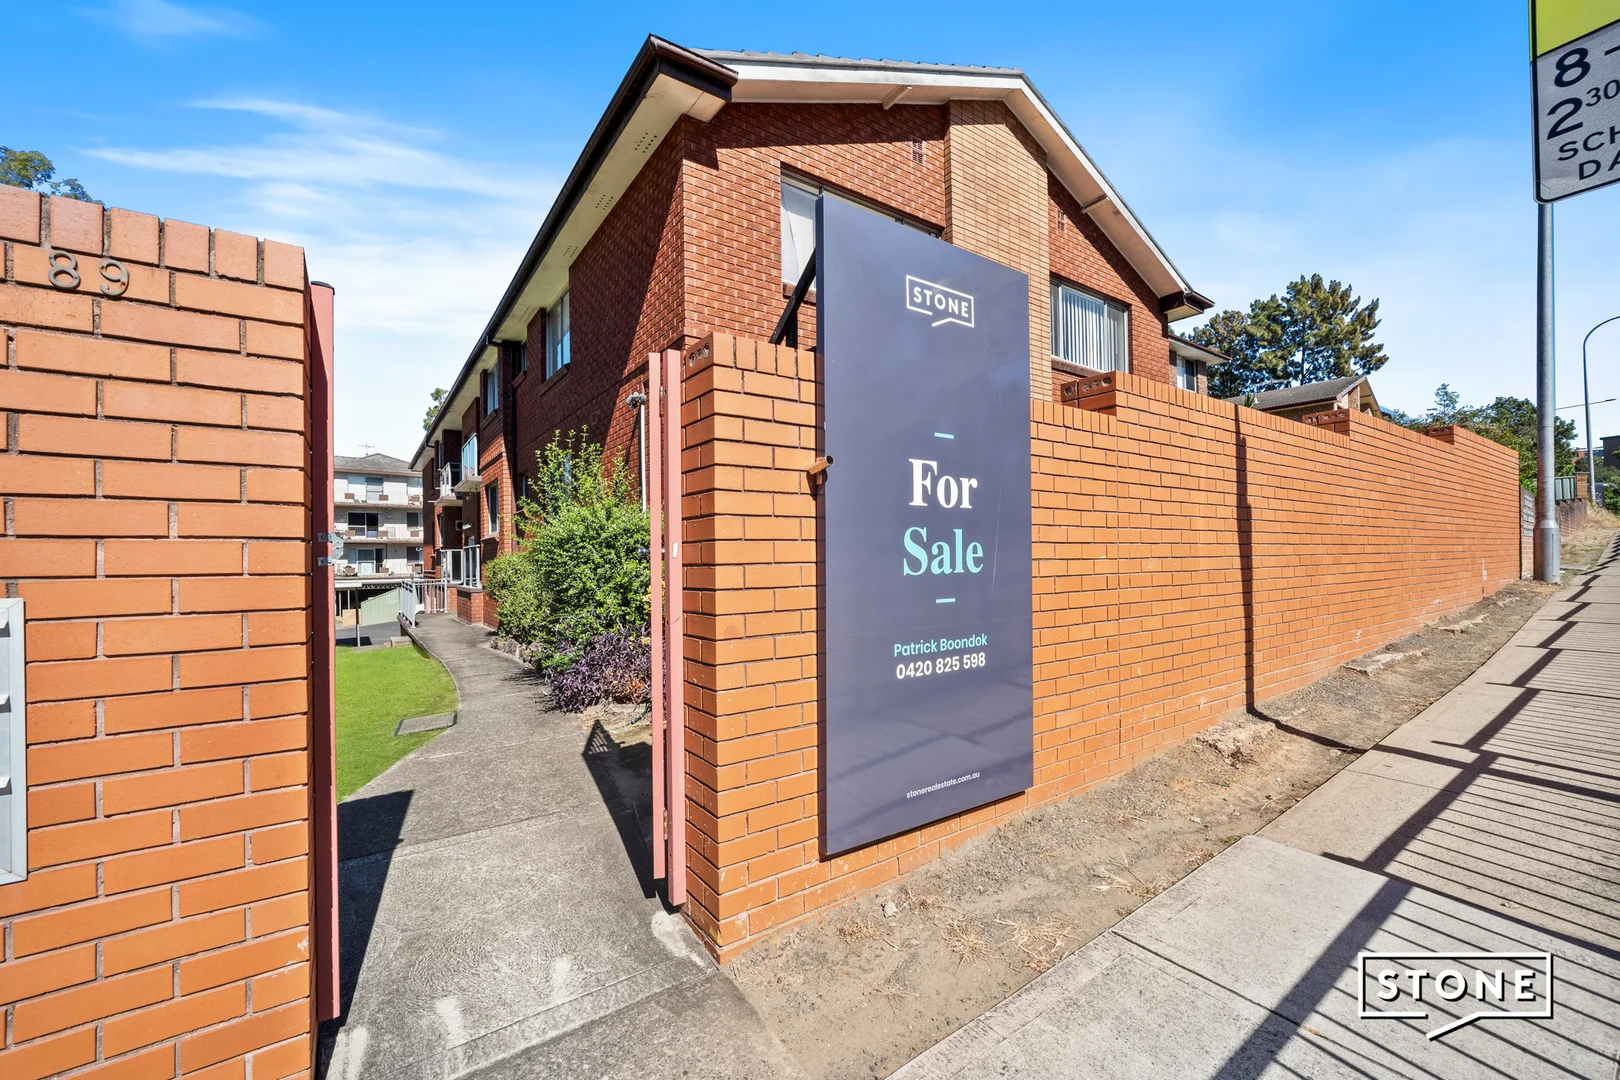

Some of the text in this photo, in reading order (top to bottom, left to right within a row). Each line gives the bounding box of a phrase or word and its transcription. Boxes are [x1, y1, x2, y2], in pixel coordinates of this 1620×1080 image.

[1554, 47, 1591, 88] 8
[48, 250, 130, 297] 89
[913, 286, 969, 318] STONE
[908, 458, 978, 509] For
[903, 526, 984, 576] Sale
[894, 633, 988, 657] Patrick Boondok
[896, 652, 986, 679] 0420 825 598
[906, 772, 980, 798] stonerealestate.com.au
